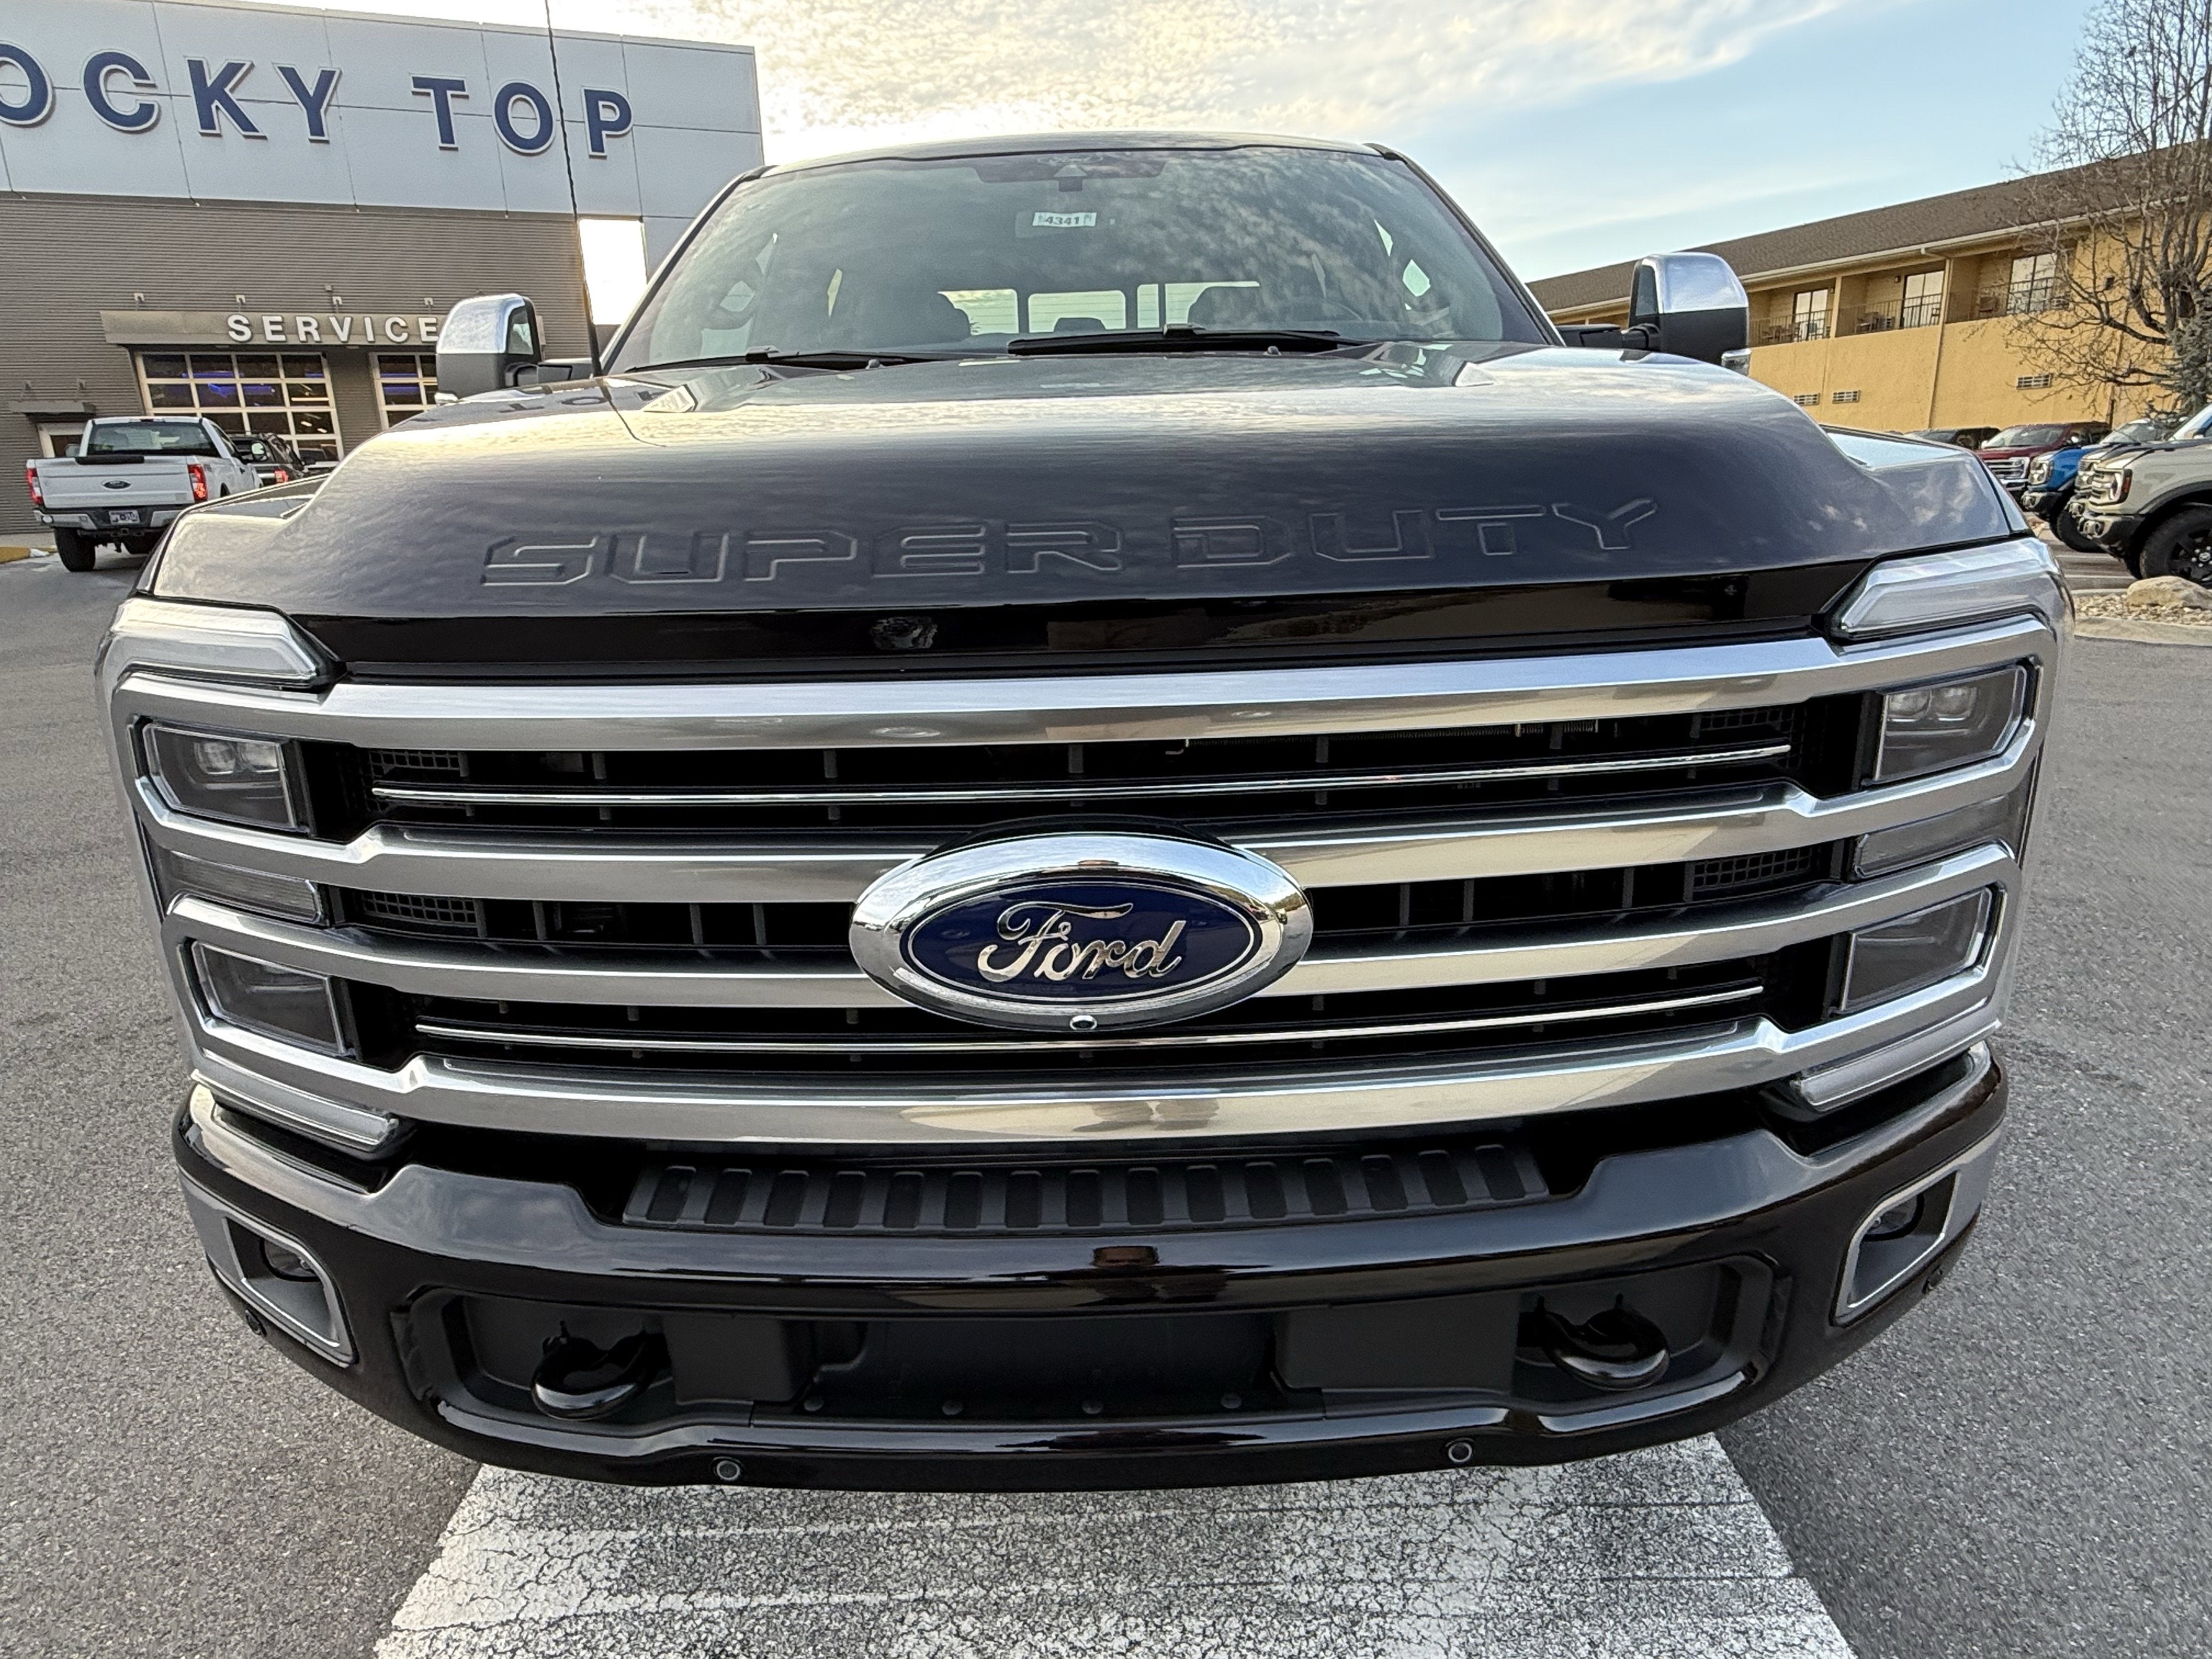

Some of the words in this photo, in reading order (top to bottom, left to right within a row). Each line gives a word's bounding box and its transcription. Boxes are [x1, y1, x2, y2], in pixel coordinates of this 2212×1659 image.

[410, 76, 633, 158] TOP
[1045, 216, 1080, 224] 4341
[227, 314, 438, 343] SERVICE
[481, 518, 1125, 586] SUPER
[1171, 498, 1658, 568] DUTY
[978, 901, 1186, 982] Ford
